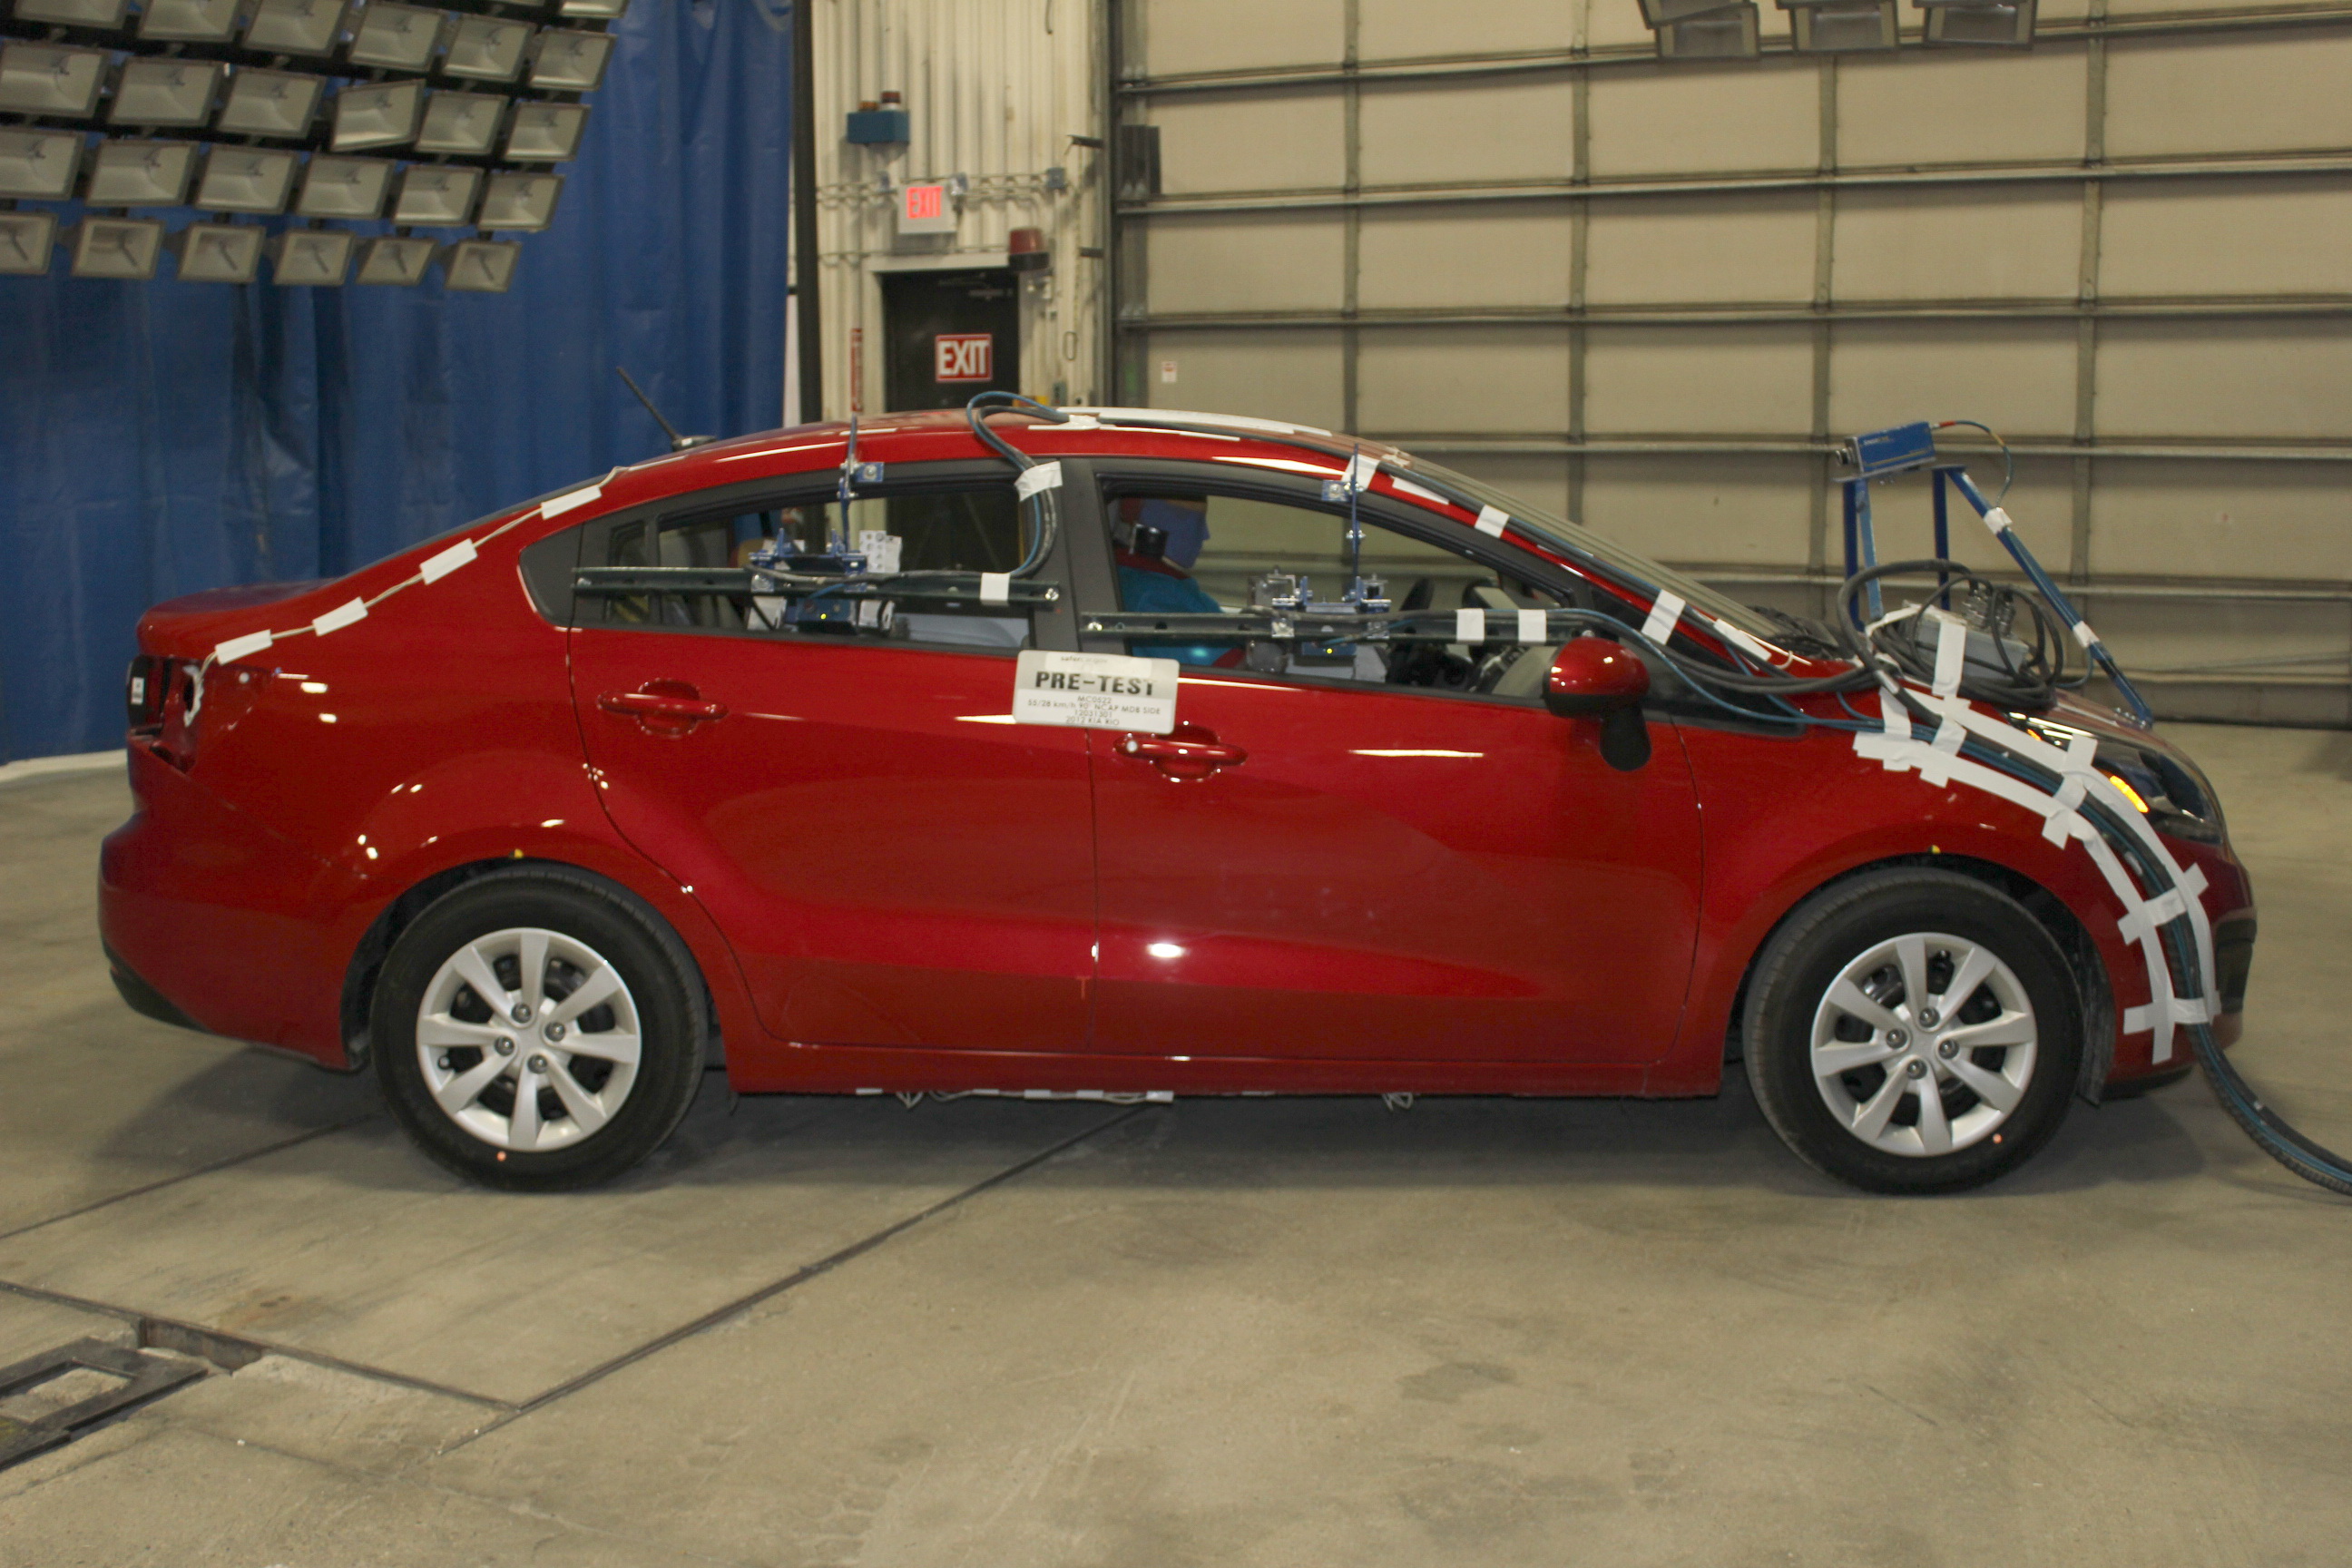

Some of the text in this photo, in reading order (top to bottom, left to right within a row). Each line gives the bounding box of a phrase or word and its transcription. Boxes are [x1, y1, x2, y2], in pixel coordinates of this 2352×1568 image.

[906, 186, 944, 219] EXIT
[937, 339, 989, 376] EXIT
[1035, 671, 1158, 696] PRE-TEST
